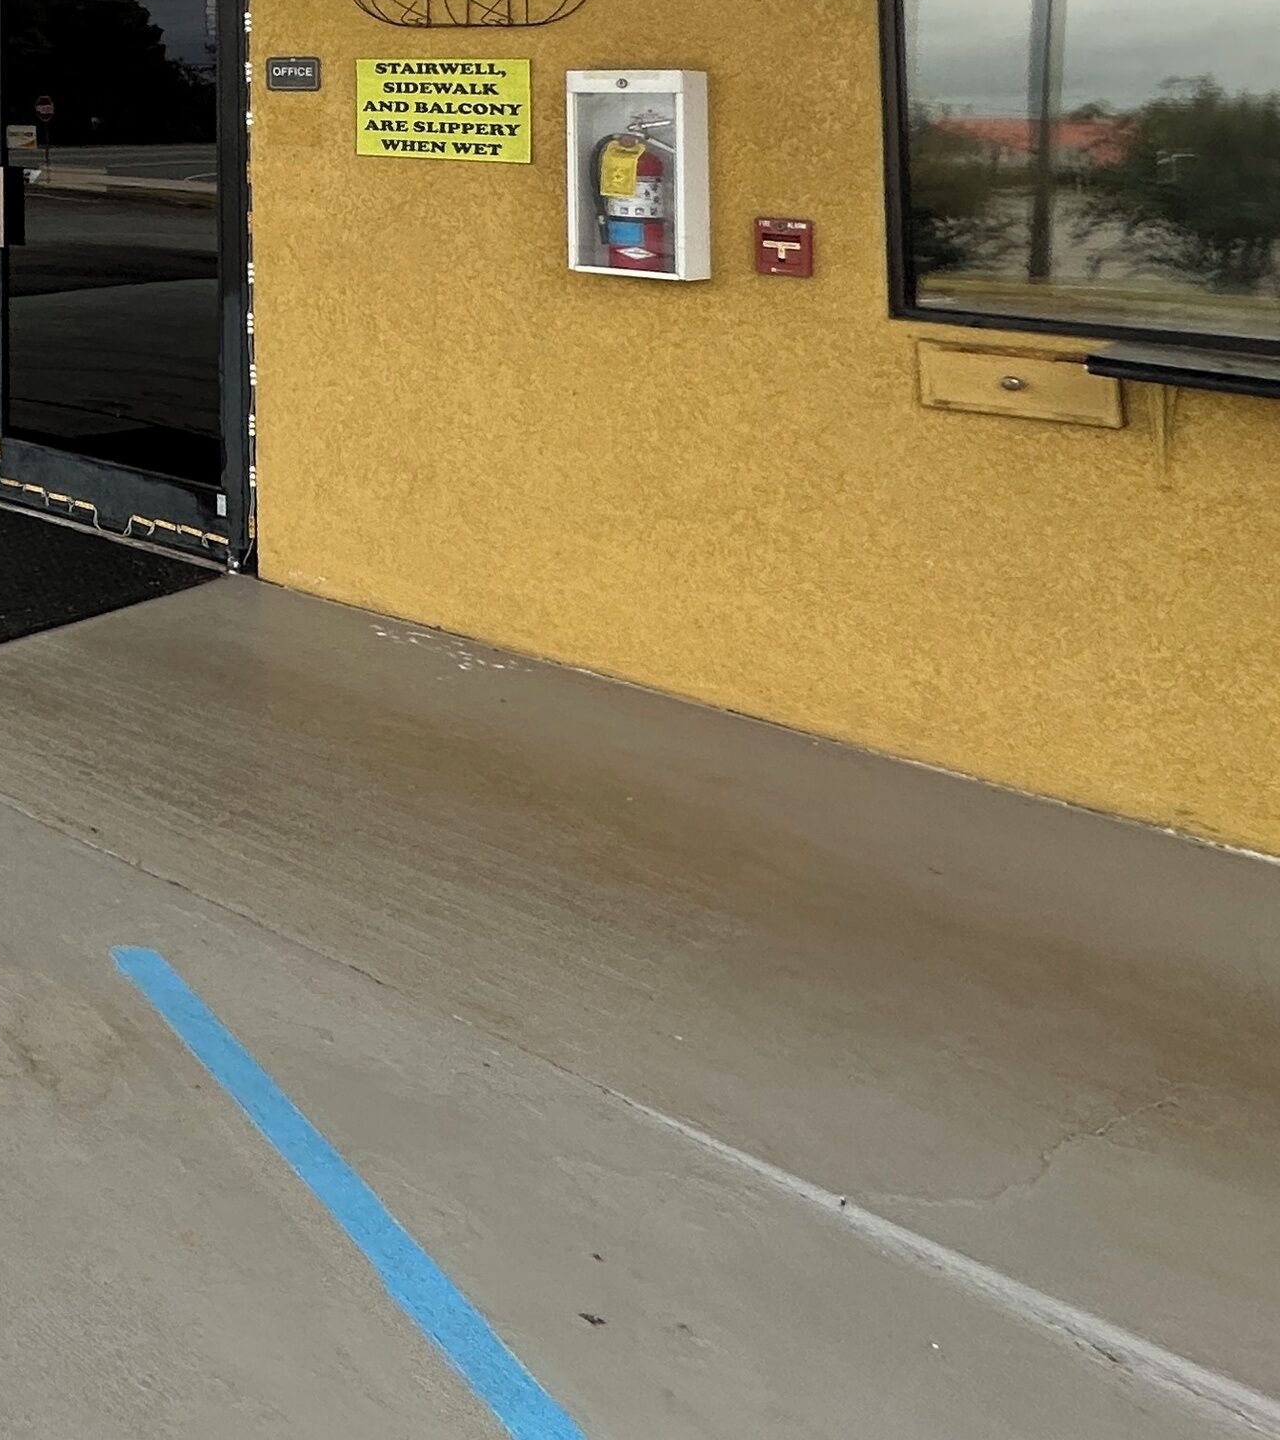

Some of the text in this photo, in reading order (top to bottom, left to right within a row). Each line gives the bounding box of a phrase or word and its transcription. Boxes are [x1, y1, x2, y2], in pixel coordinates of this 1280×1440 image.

[272, 66, 313, 77] OFFICE
[374, 62, 507, 77] STAIRWELL,
[383, 81, 499, 95] SIDEWALK
[362, 100, 523, 116] AND BALCONY
[364, 119, 521, 137] ARE SLIPPERY
[380, 138, 503, 156] WHEN WET
